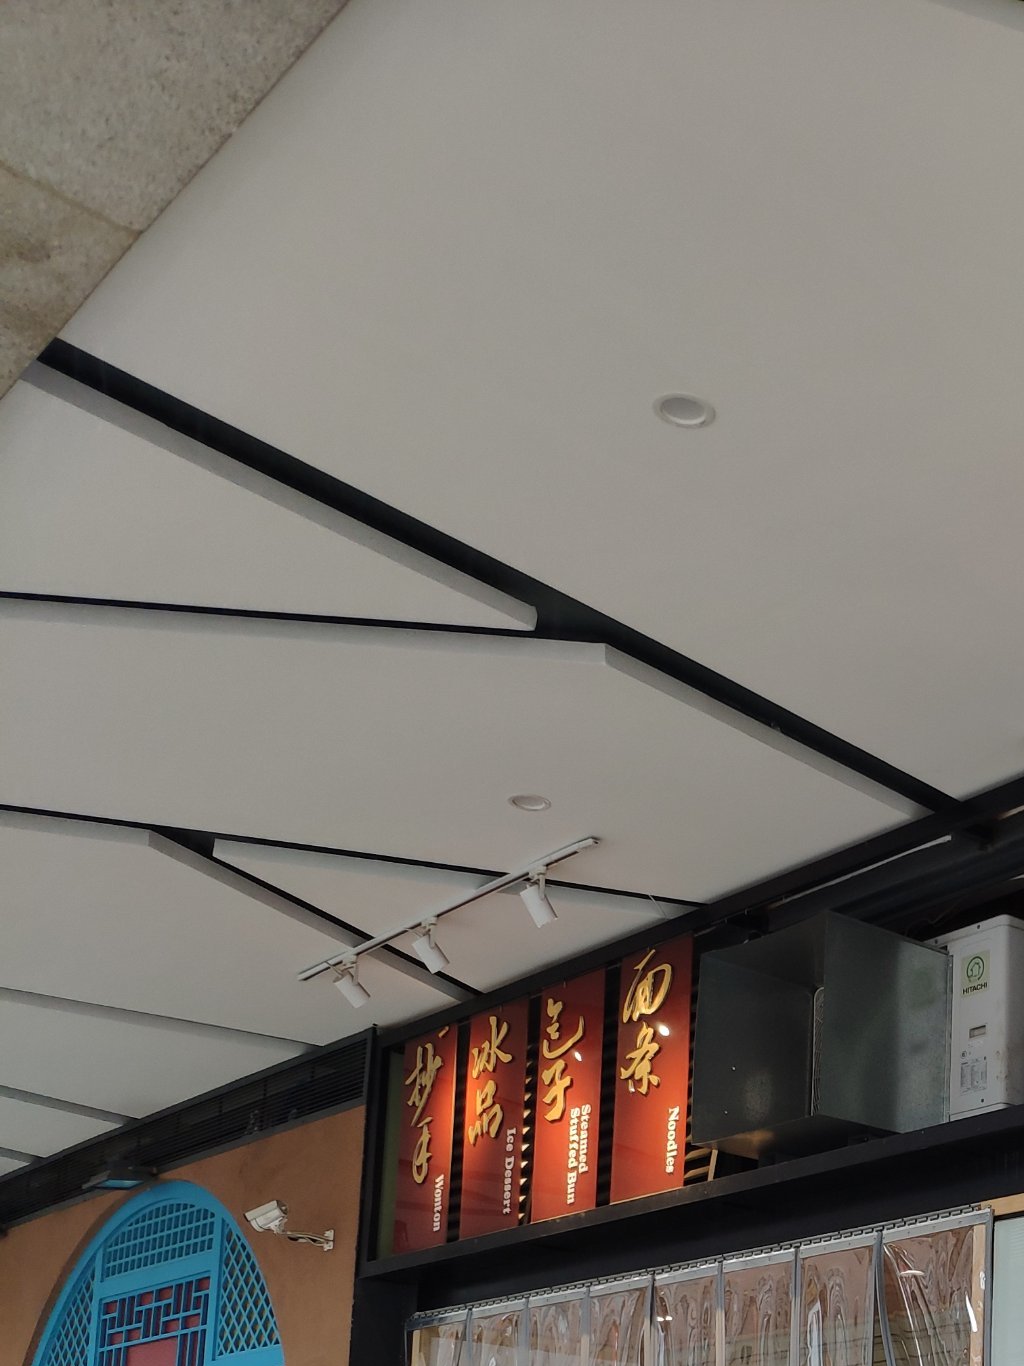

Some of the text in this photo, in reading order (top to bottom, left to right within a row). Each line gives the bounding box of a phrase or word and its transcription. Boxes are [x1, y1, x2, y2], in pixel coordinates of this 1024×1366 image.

[962, 982, 988, 995] HITACHI
[467, 1015, 513, 1146] 冰品
[541, 998, 586, 1122] 包子
[405, 1025, 450, 1184] 抄手
[578, 1103, 592, 1174] Steamed
[665, 1105, 681, 1174] Noodles
[502, 1127, 517, 1215] Ice Dessert
[566, 1106, 581, 1205] Stuffed Bun
[432, 1174, 445, 1232] Wonton
